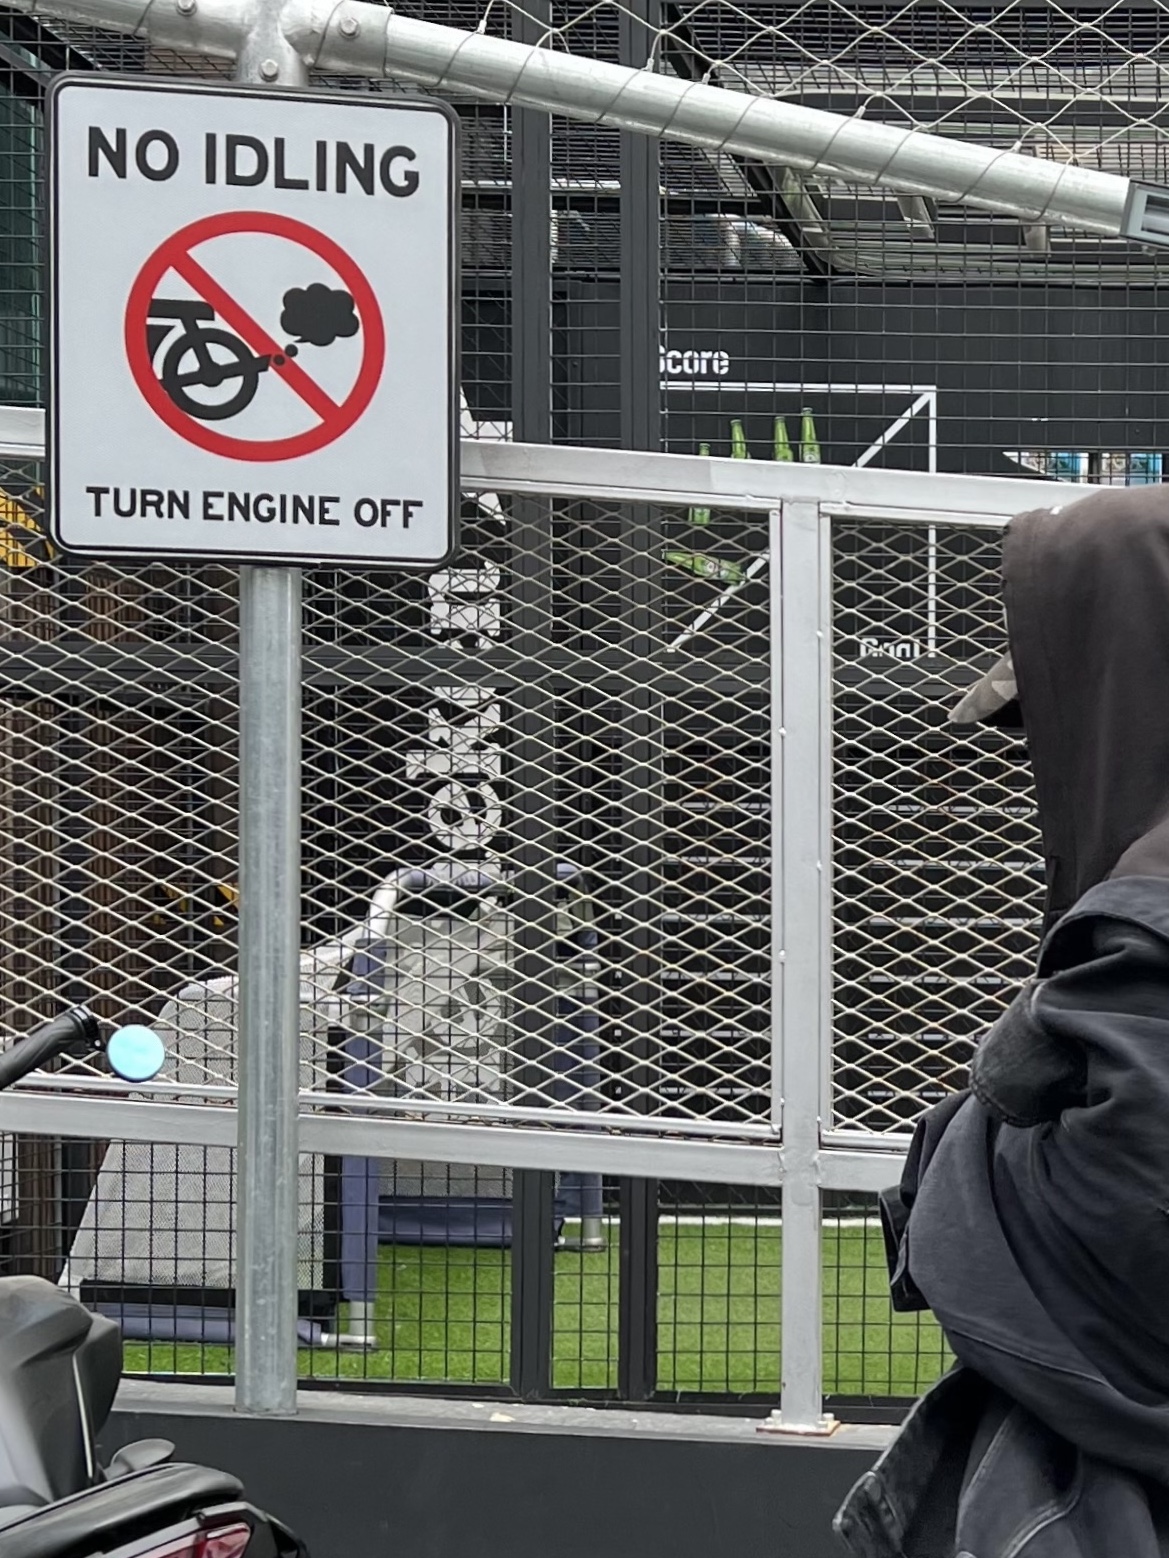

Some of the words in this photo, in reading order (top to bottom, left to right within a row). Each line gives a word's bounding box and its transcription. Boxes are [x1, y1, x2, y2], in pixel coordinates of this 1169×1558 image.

[88, 125, 180, 182] NO
[205, 132, 420, 198] IDLING
[86, 486, 190, 519] TURN
[202, 490, 341, 526] ENGINE
[354, 497, 424, 529] OFF
